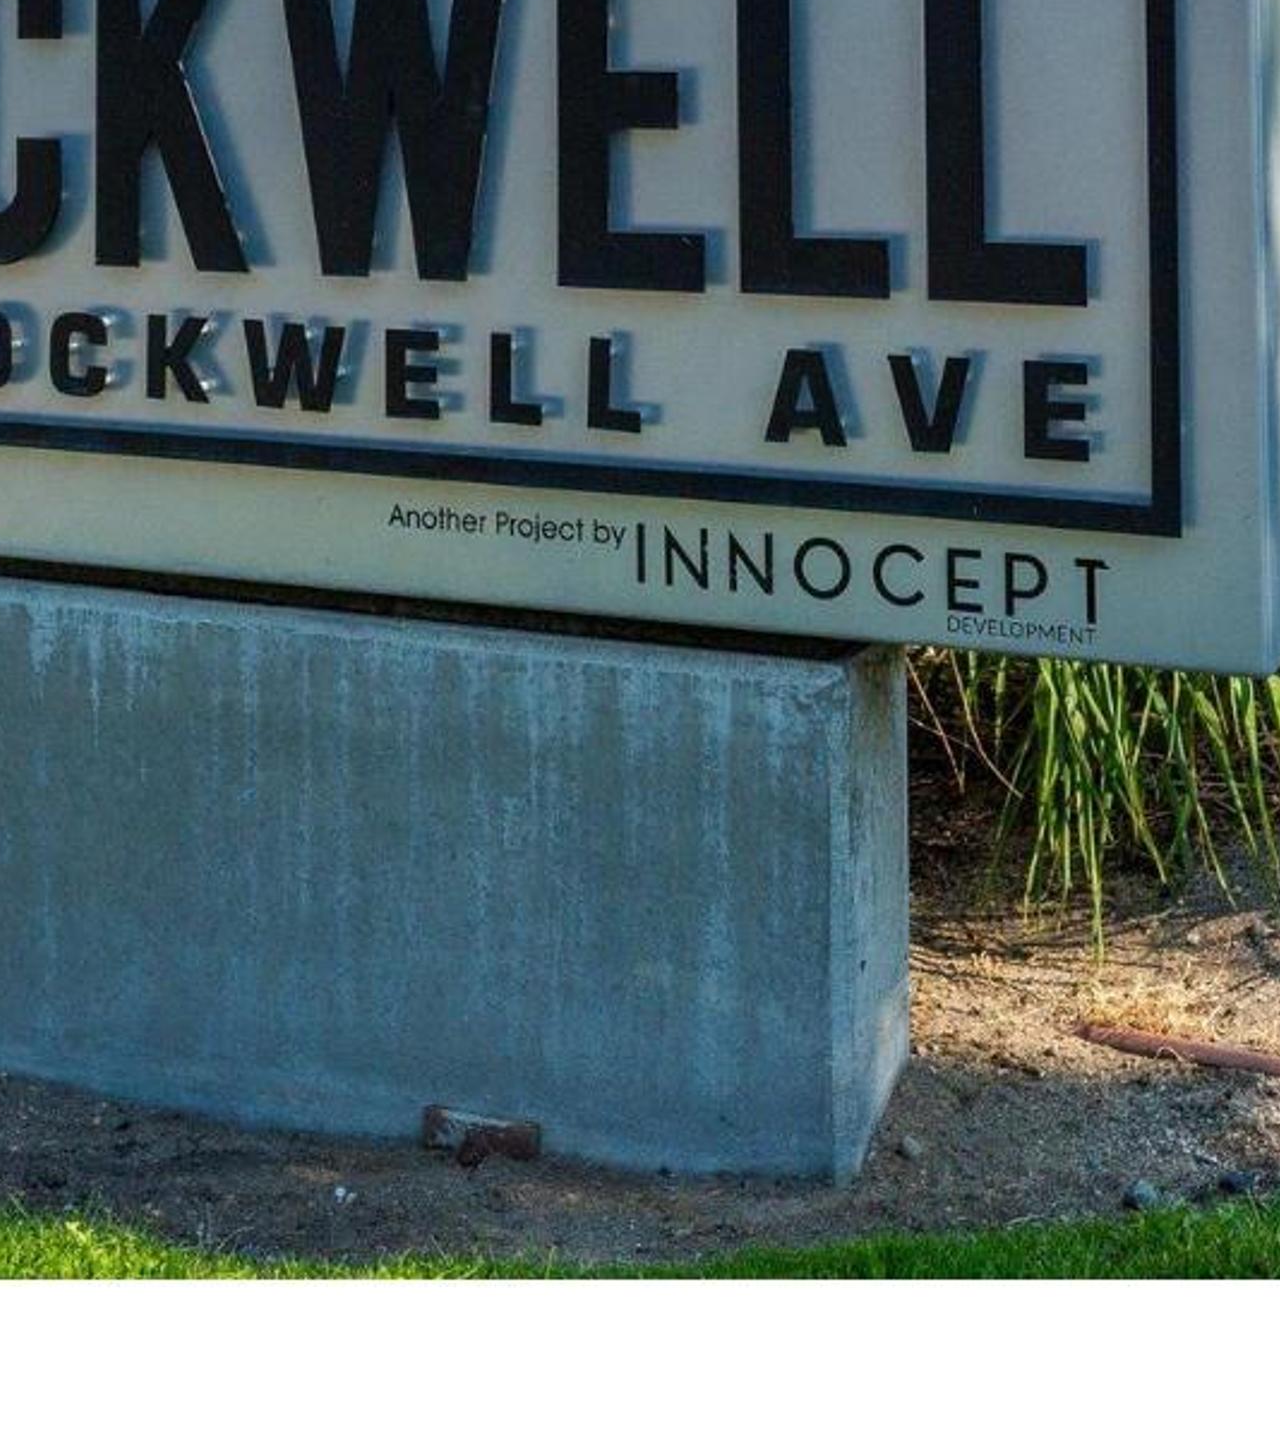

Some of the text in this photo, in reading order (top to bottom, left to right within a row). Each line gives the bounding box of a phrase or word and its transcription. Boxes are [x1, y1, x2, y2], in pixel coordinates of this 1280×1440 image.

[764, 348, 1092, 463] AVE
[388, 502, 1110, 626] Another Project by INNOCEPT
[946, 614, 1098, 646] DEVELOPMENT
